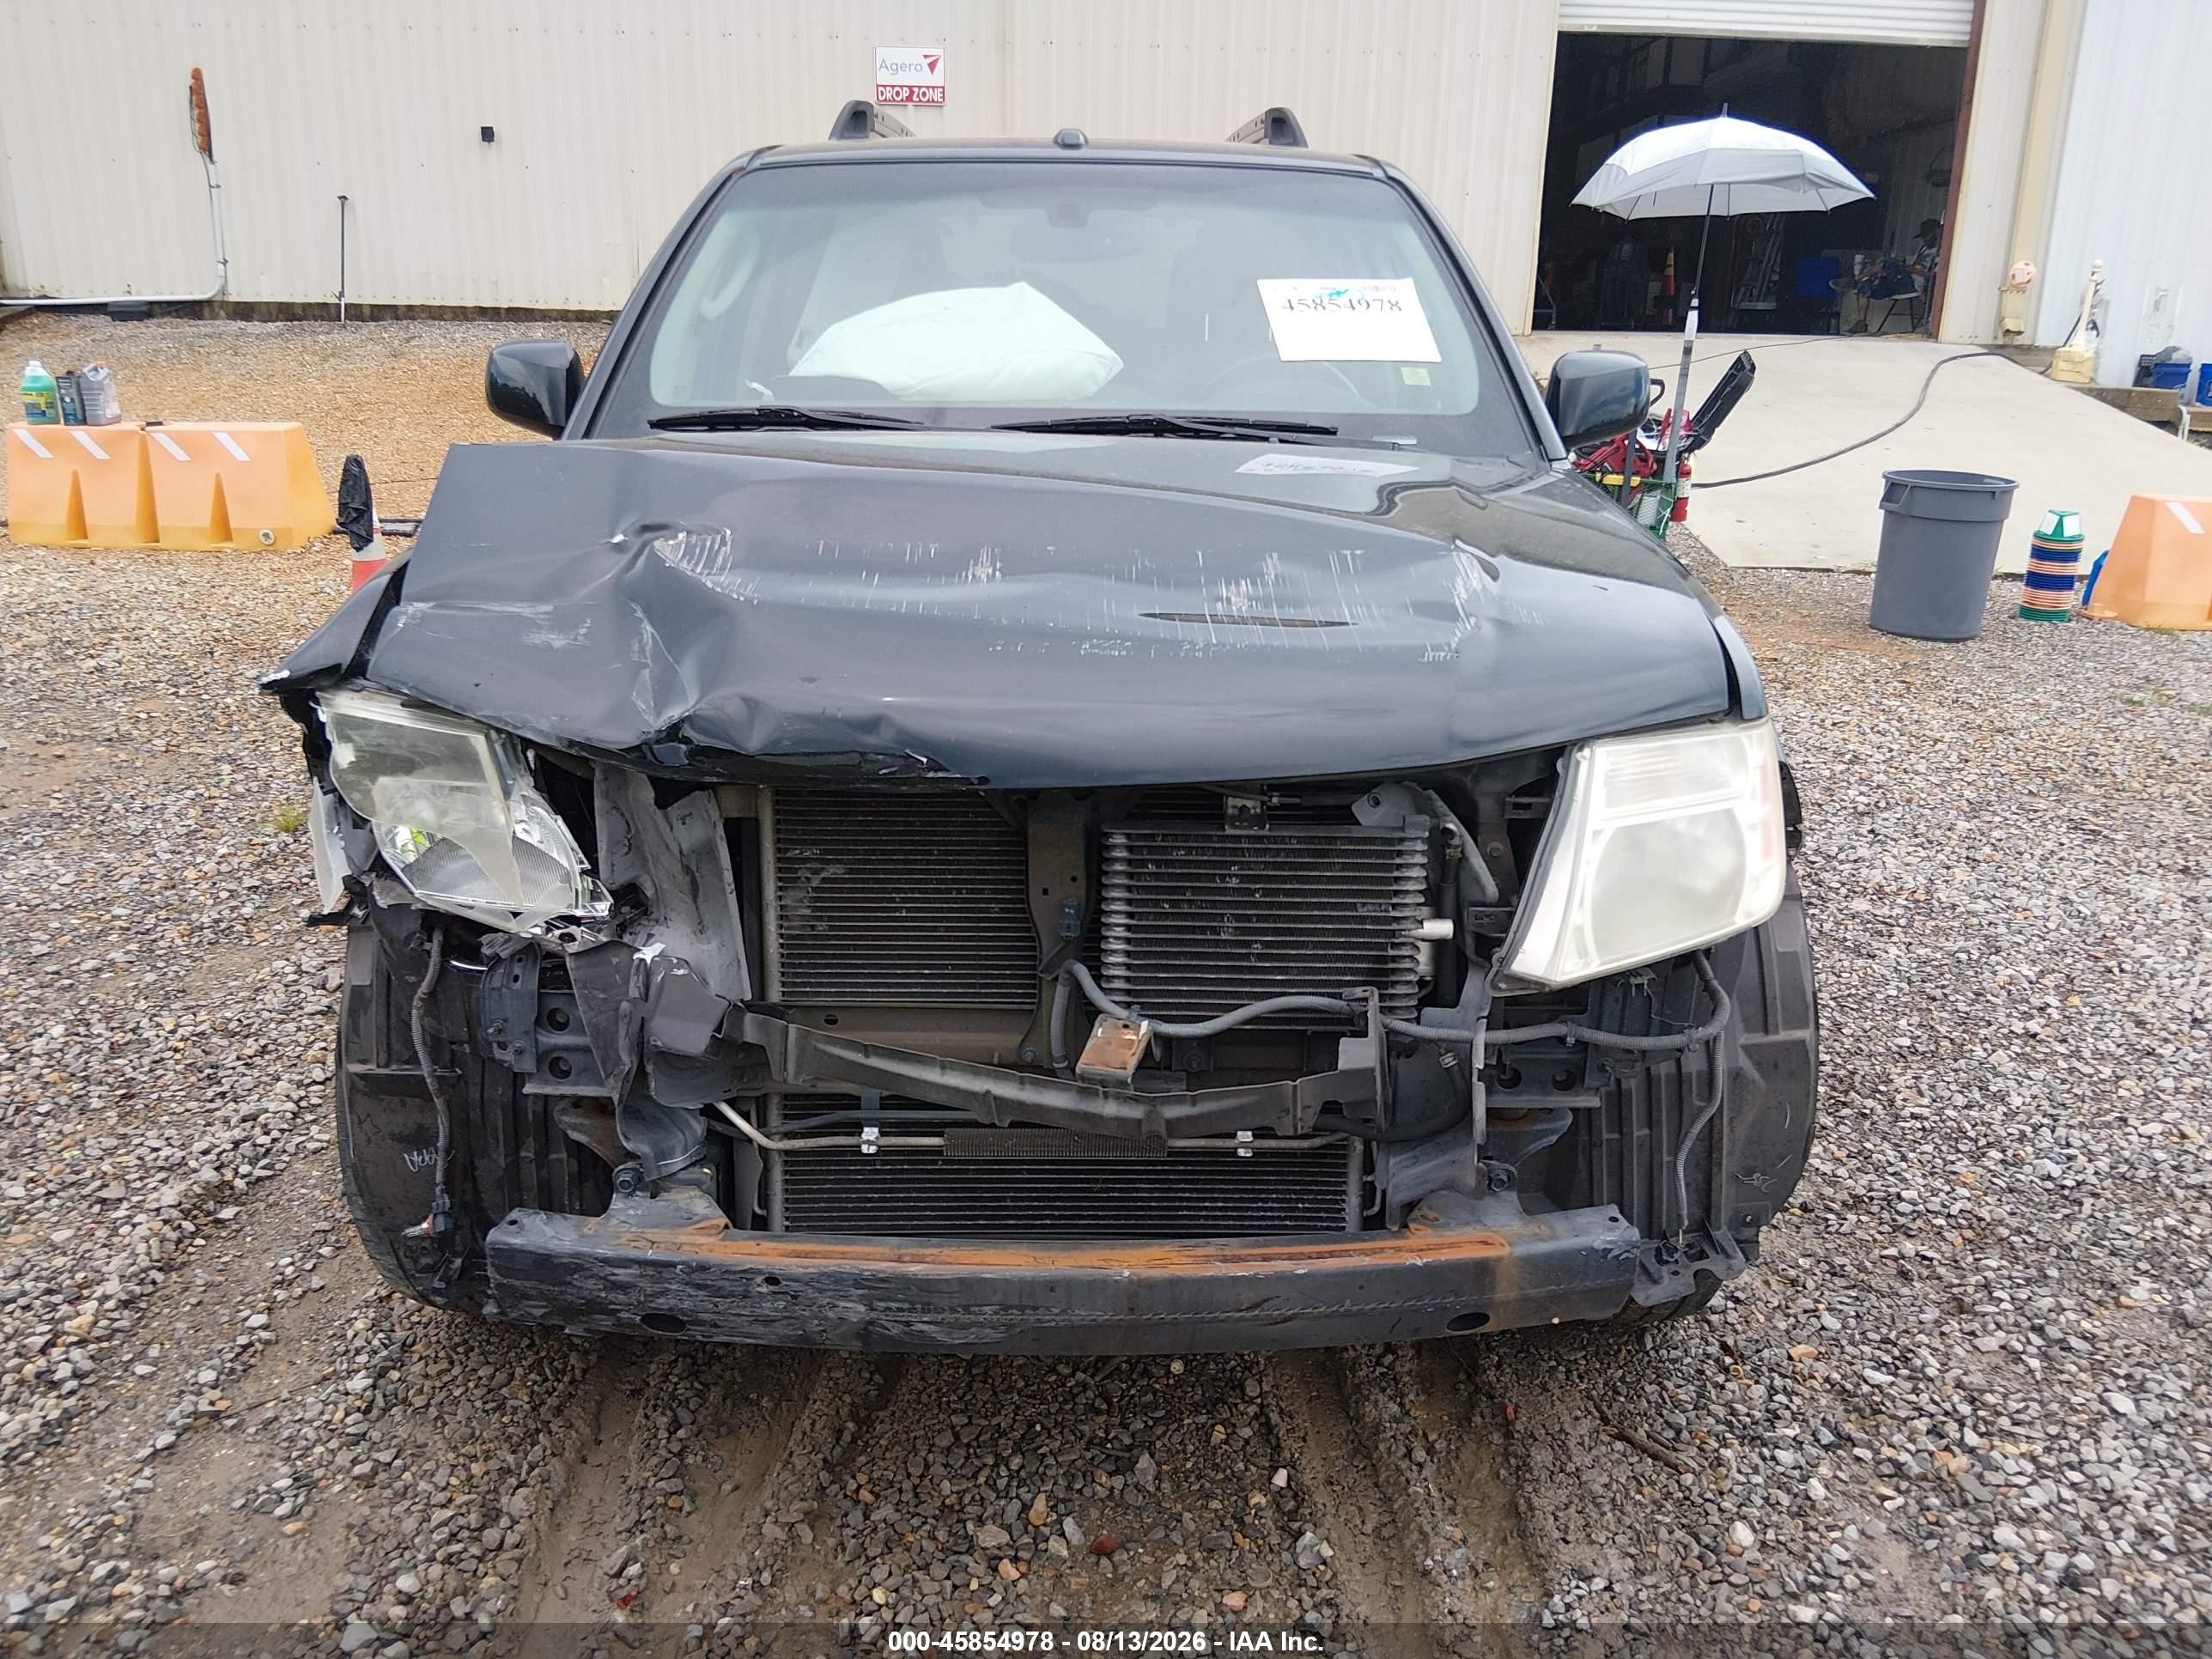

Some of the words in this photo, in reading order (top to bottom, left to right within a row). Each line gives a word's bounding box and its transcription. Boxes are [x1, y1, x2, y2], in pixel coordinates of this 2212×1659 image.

[878, 58, 923, 76] Agero
[878, 87, 909, 101] DROP
[912, 88, 943, 101] ZONE
[1281, 298, 1404, 313] 45854978
